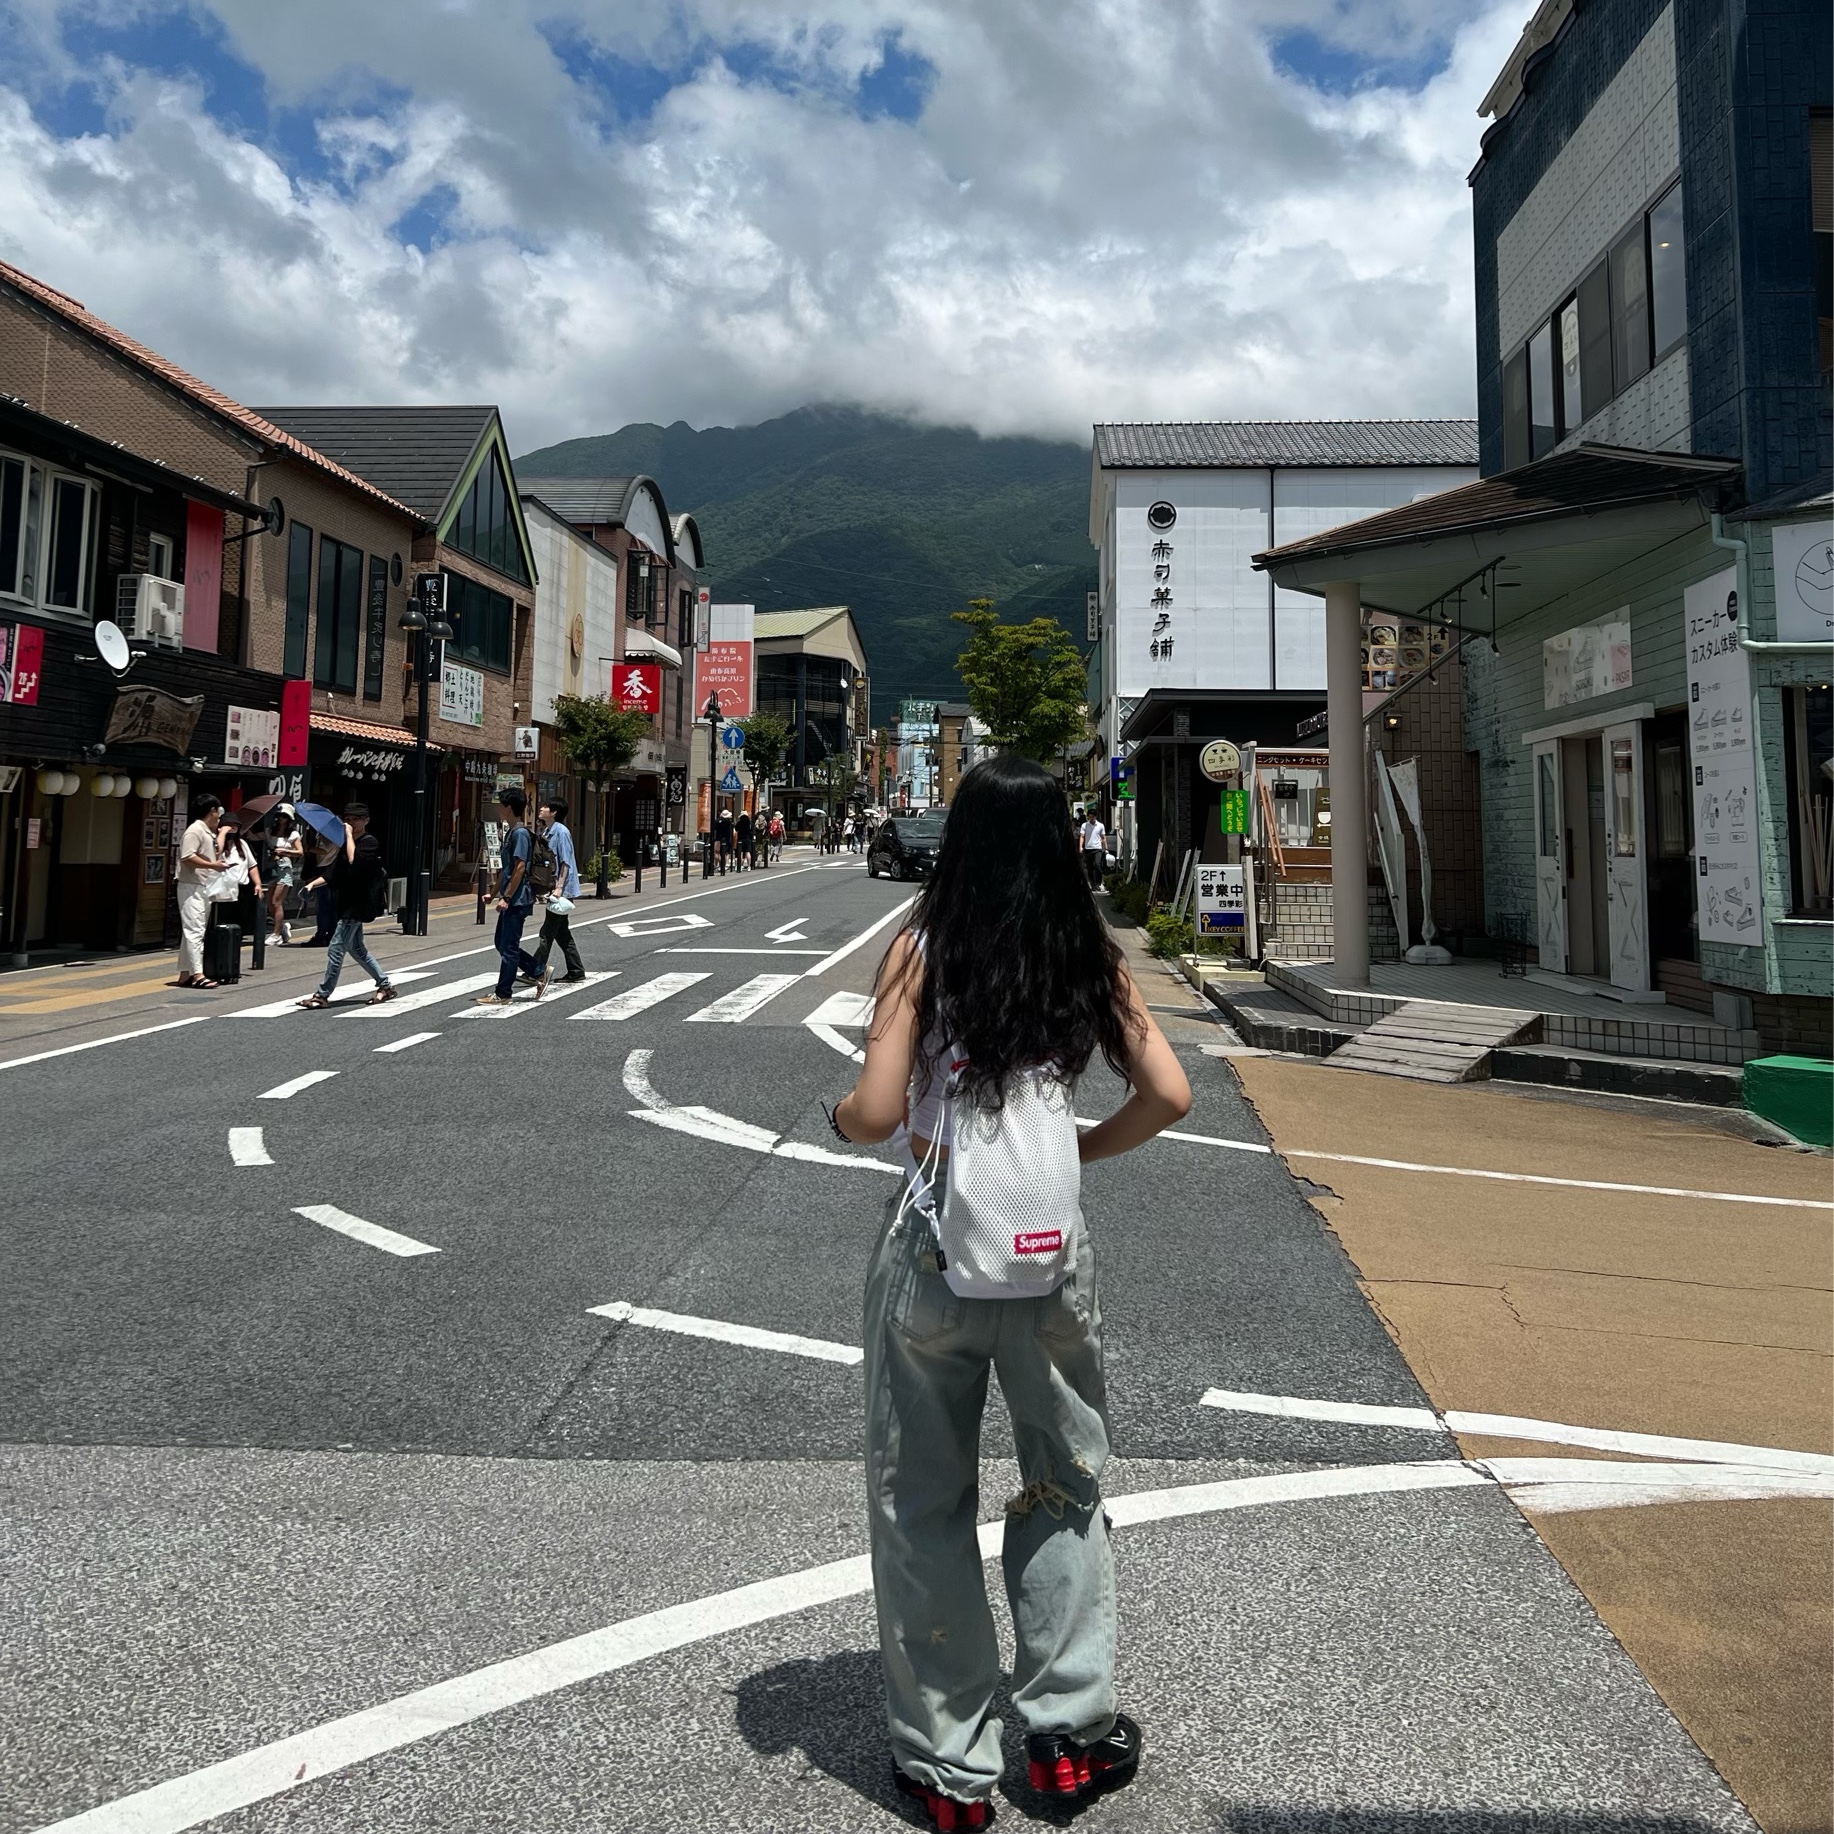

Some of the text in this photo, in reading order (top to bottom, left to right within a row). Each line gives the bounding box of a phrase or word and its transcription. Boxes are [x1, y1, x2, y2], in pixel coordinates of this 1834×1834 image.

[1150, 538, 1174, 659] 赤司菓子舗
[1690, 609, 1727, 637] スニーカー
[1691, 631, 1738, 664] カスタム体験
[622, 669, 653, 699] 香
[1200, 870, 1218, 881] 2F
[1200, 883, 1243, 898] 営業中
[1218, 900, 1243, 908] 四季彩
[1018, 1235, 1060, 1251] Supreme
